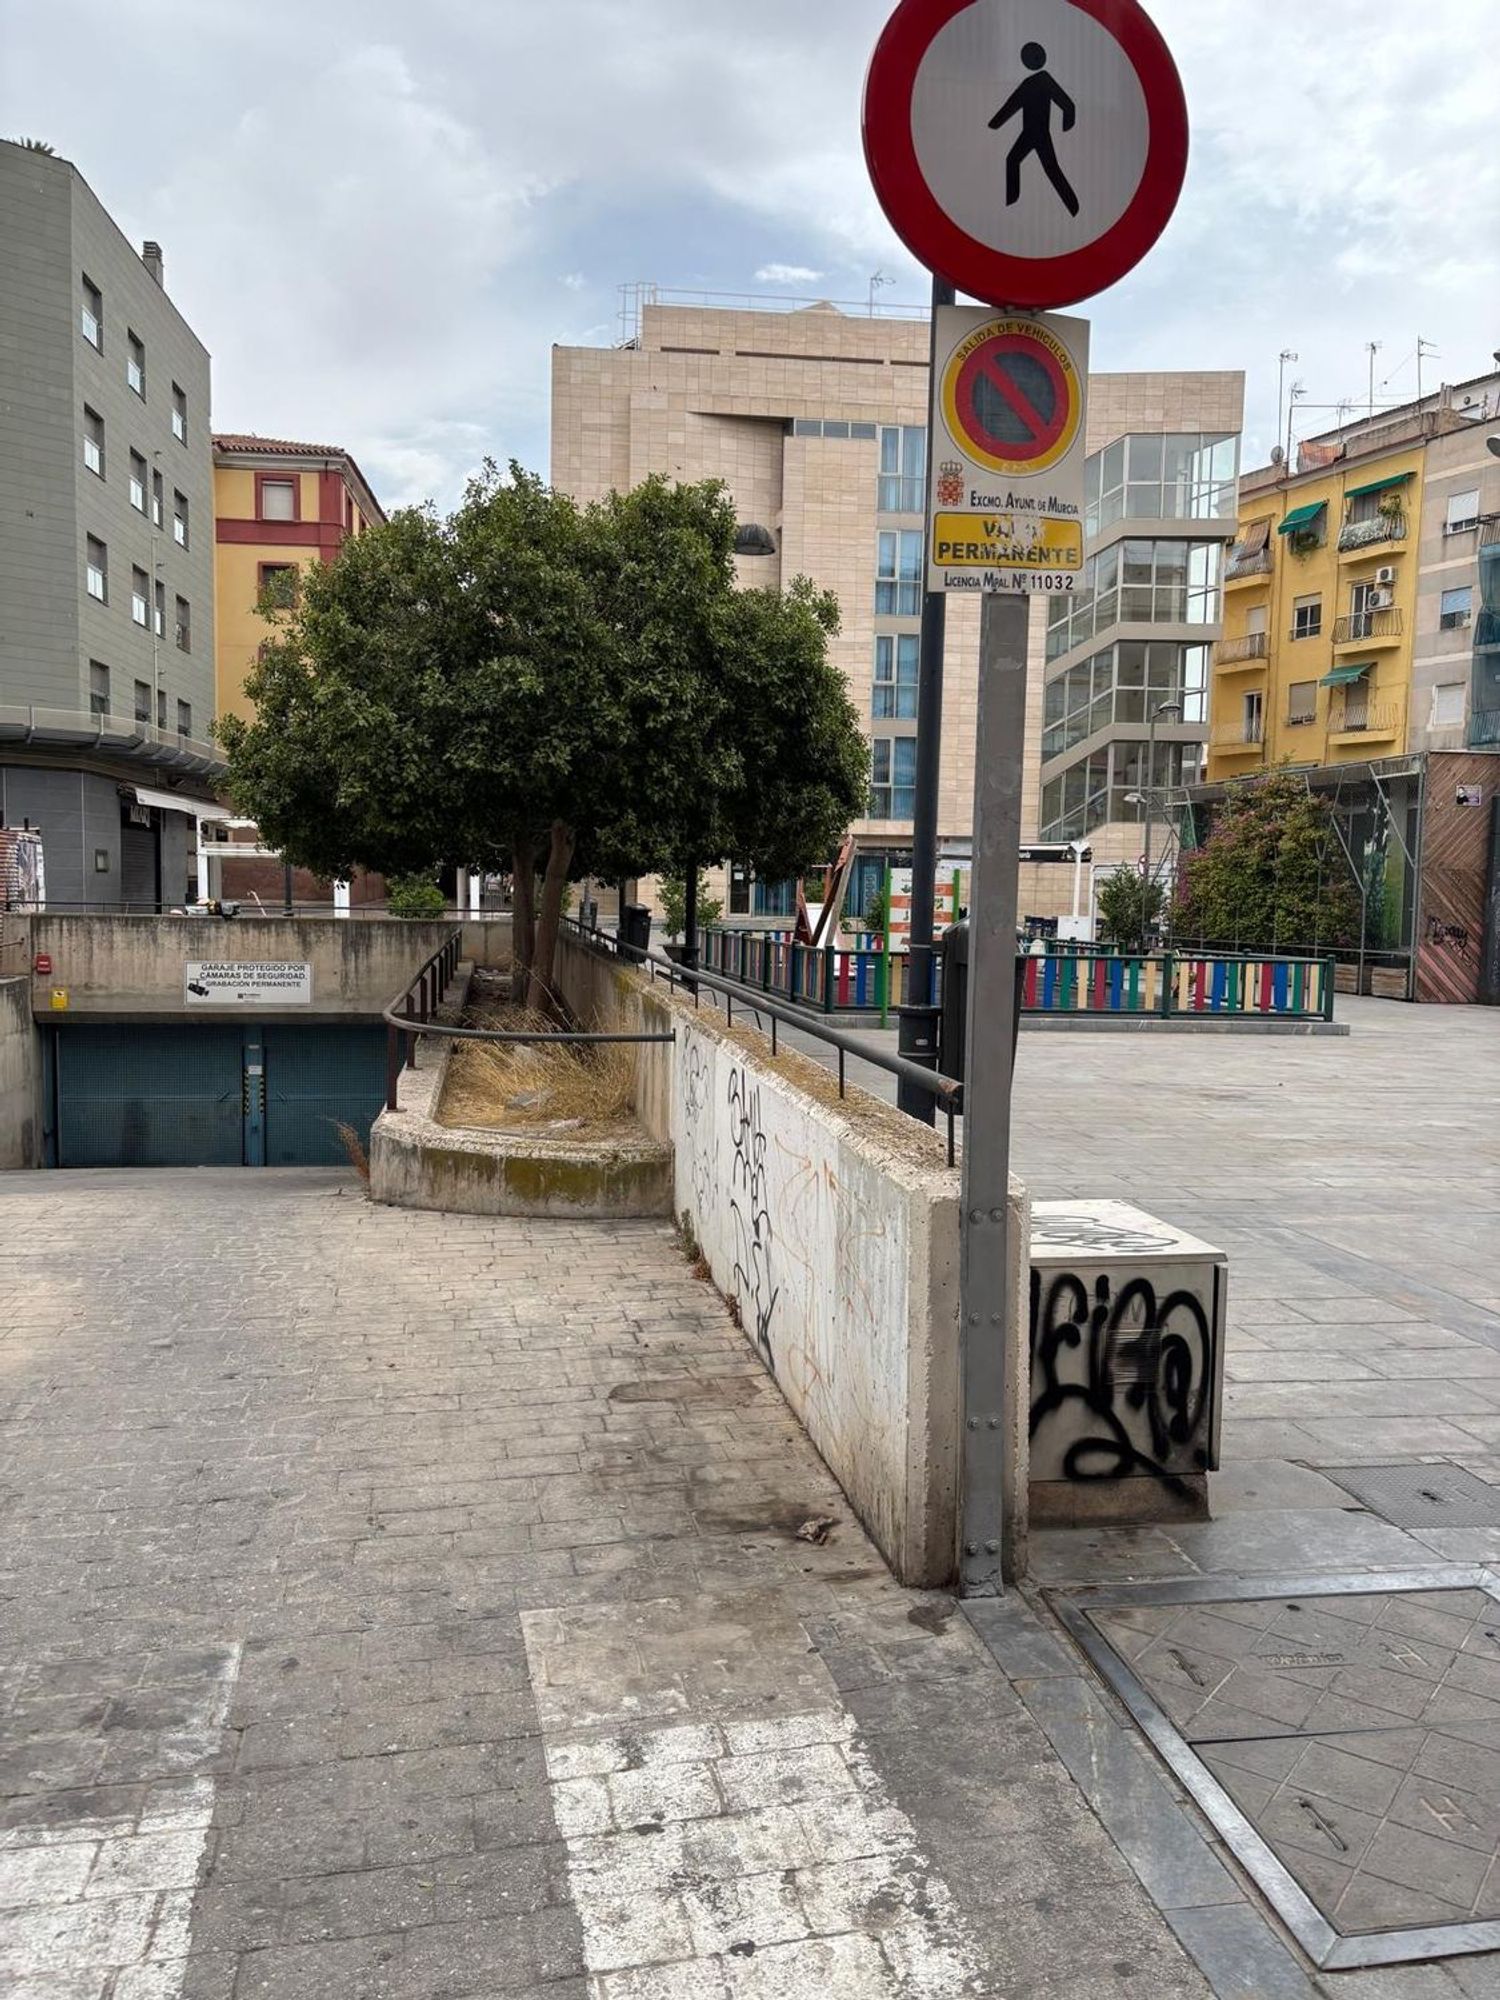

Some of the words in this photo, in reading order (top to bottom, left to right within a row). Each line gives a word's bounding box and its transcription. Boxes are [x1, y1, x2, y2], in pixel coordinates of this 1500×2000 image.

[956, 328, 995, 361] SALIDA
[997, 322, 1014, 333] DE
[1037, 500, 1047, 512] DE
[1047, 497, 1079, 514] MURCIA
[938, 542, 1078, 564] PERMANENTE
[944, 571, 981, 587] LICENCIA
[1031, 575, 1073, 590] 11032
